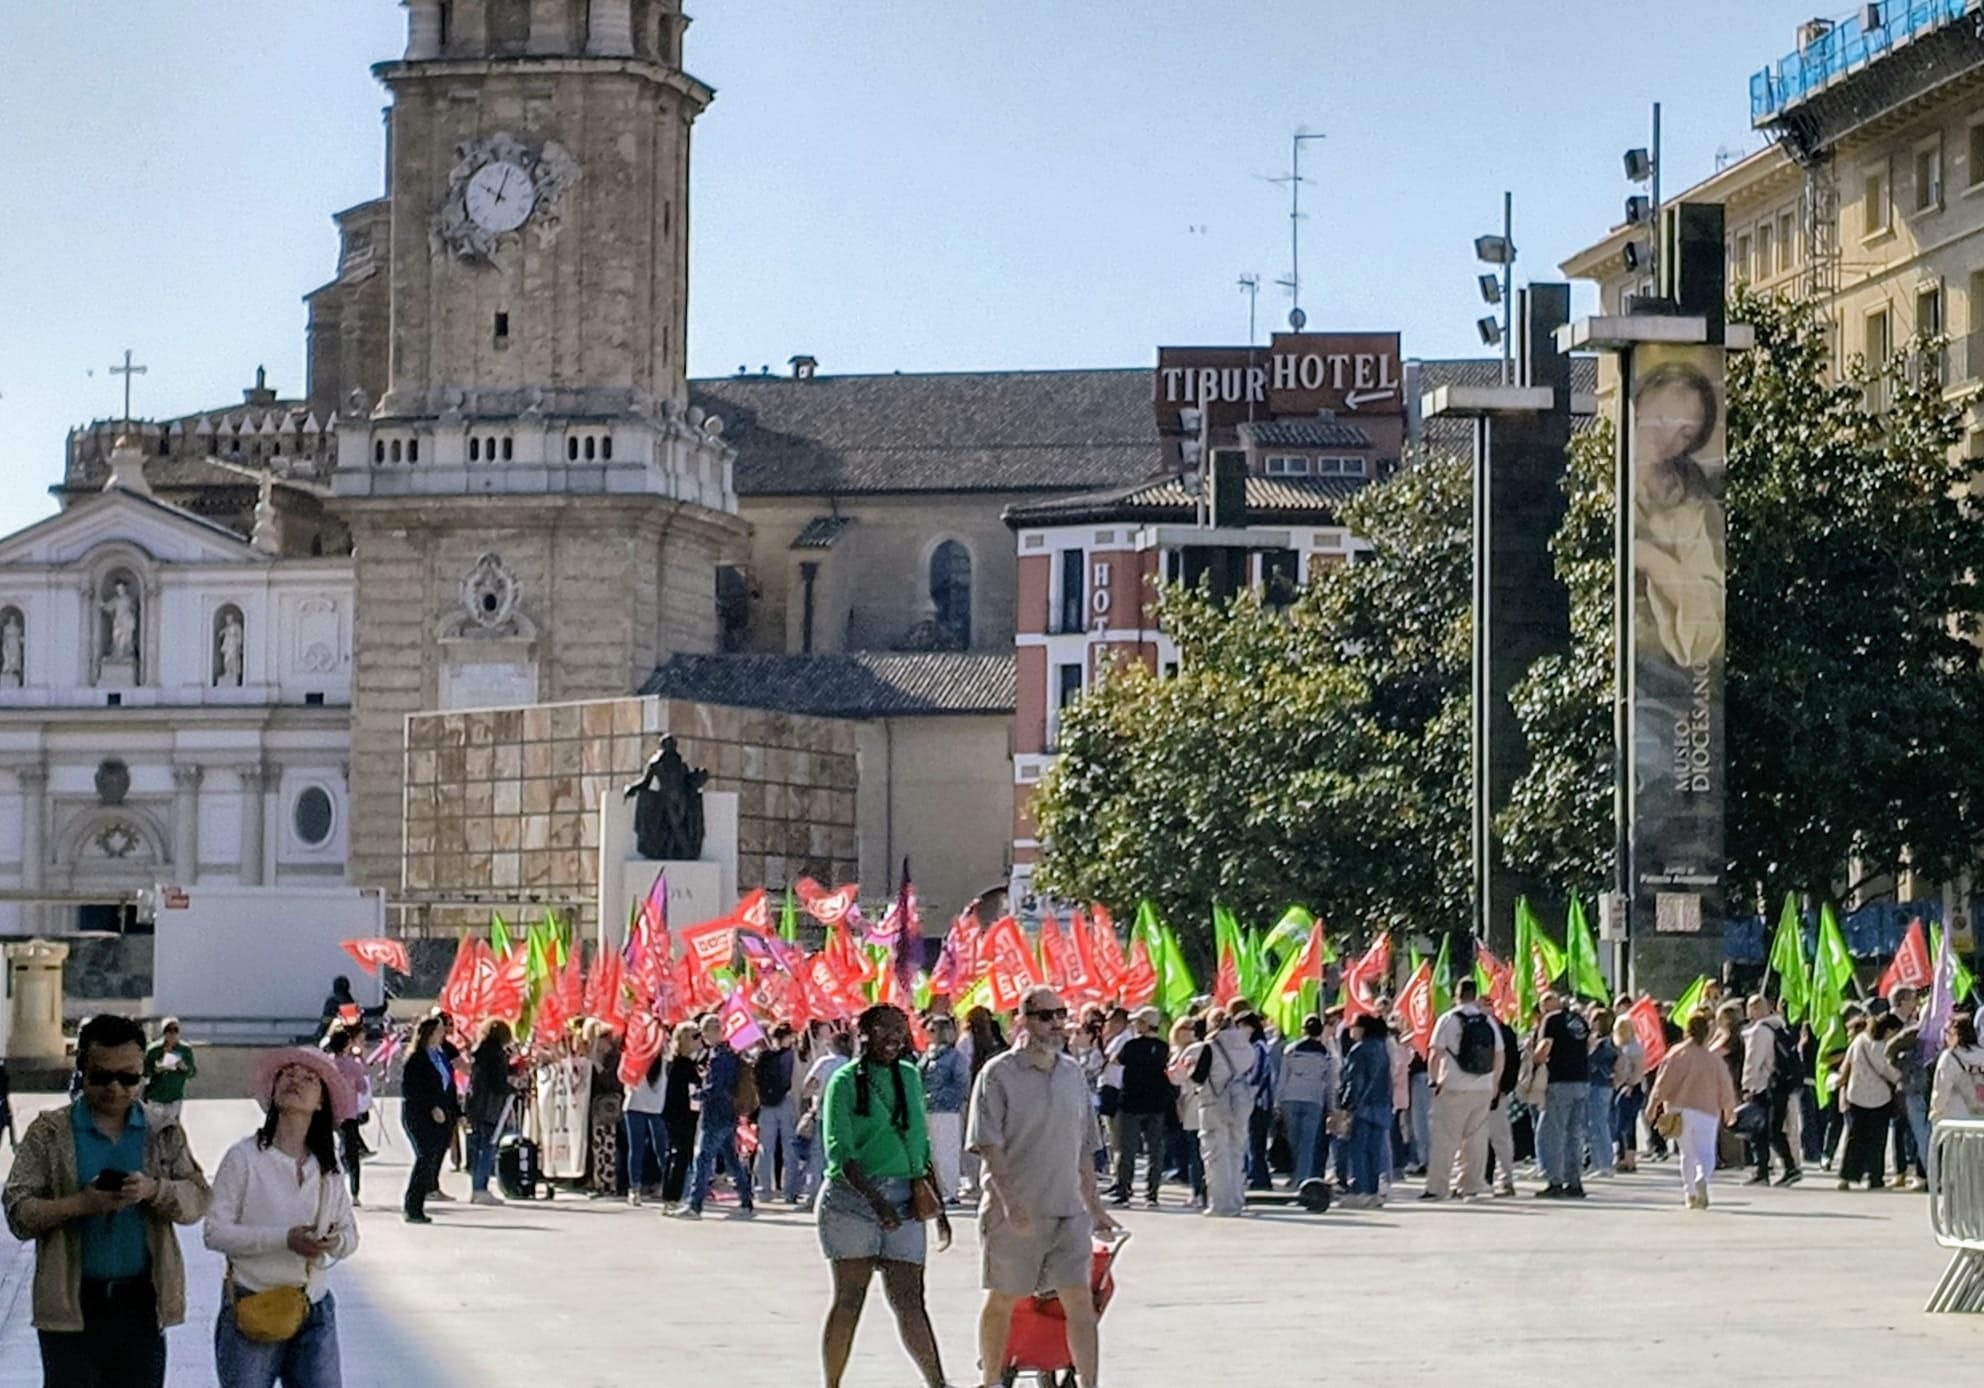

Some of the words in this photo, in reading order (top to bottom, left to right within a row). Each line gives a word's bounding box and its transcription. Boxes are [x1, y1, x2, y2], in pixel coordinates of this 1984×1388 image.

[1162, 367, 1265, 402] TIBUR
[1273, 353, 1398, 389] HOTEL
[1673, 718, 1691, 792] MUSEO
[1691, 659, 1711, 792] DIOCESANO
